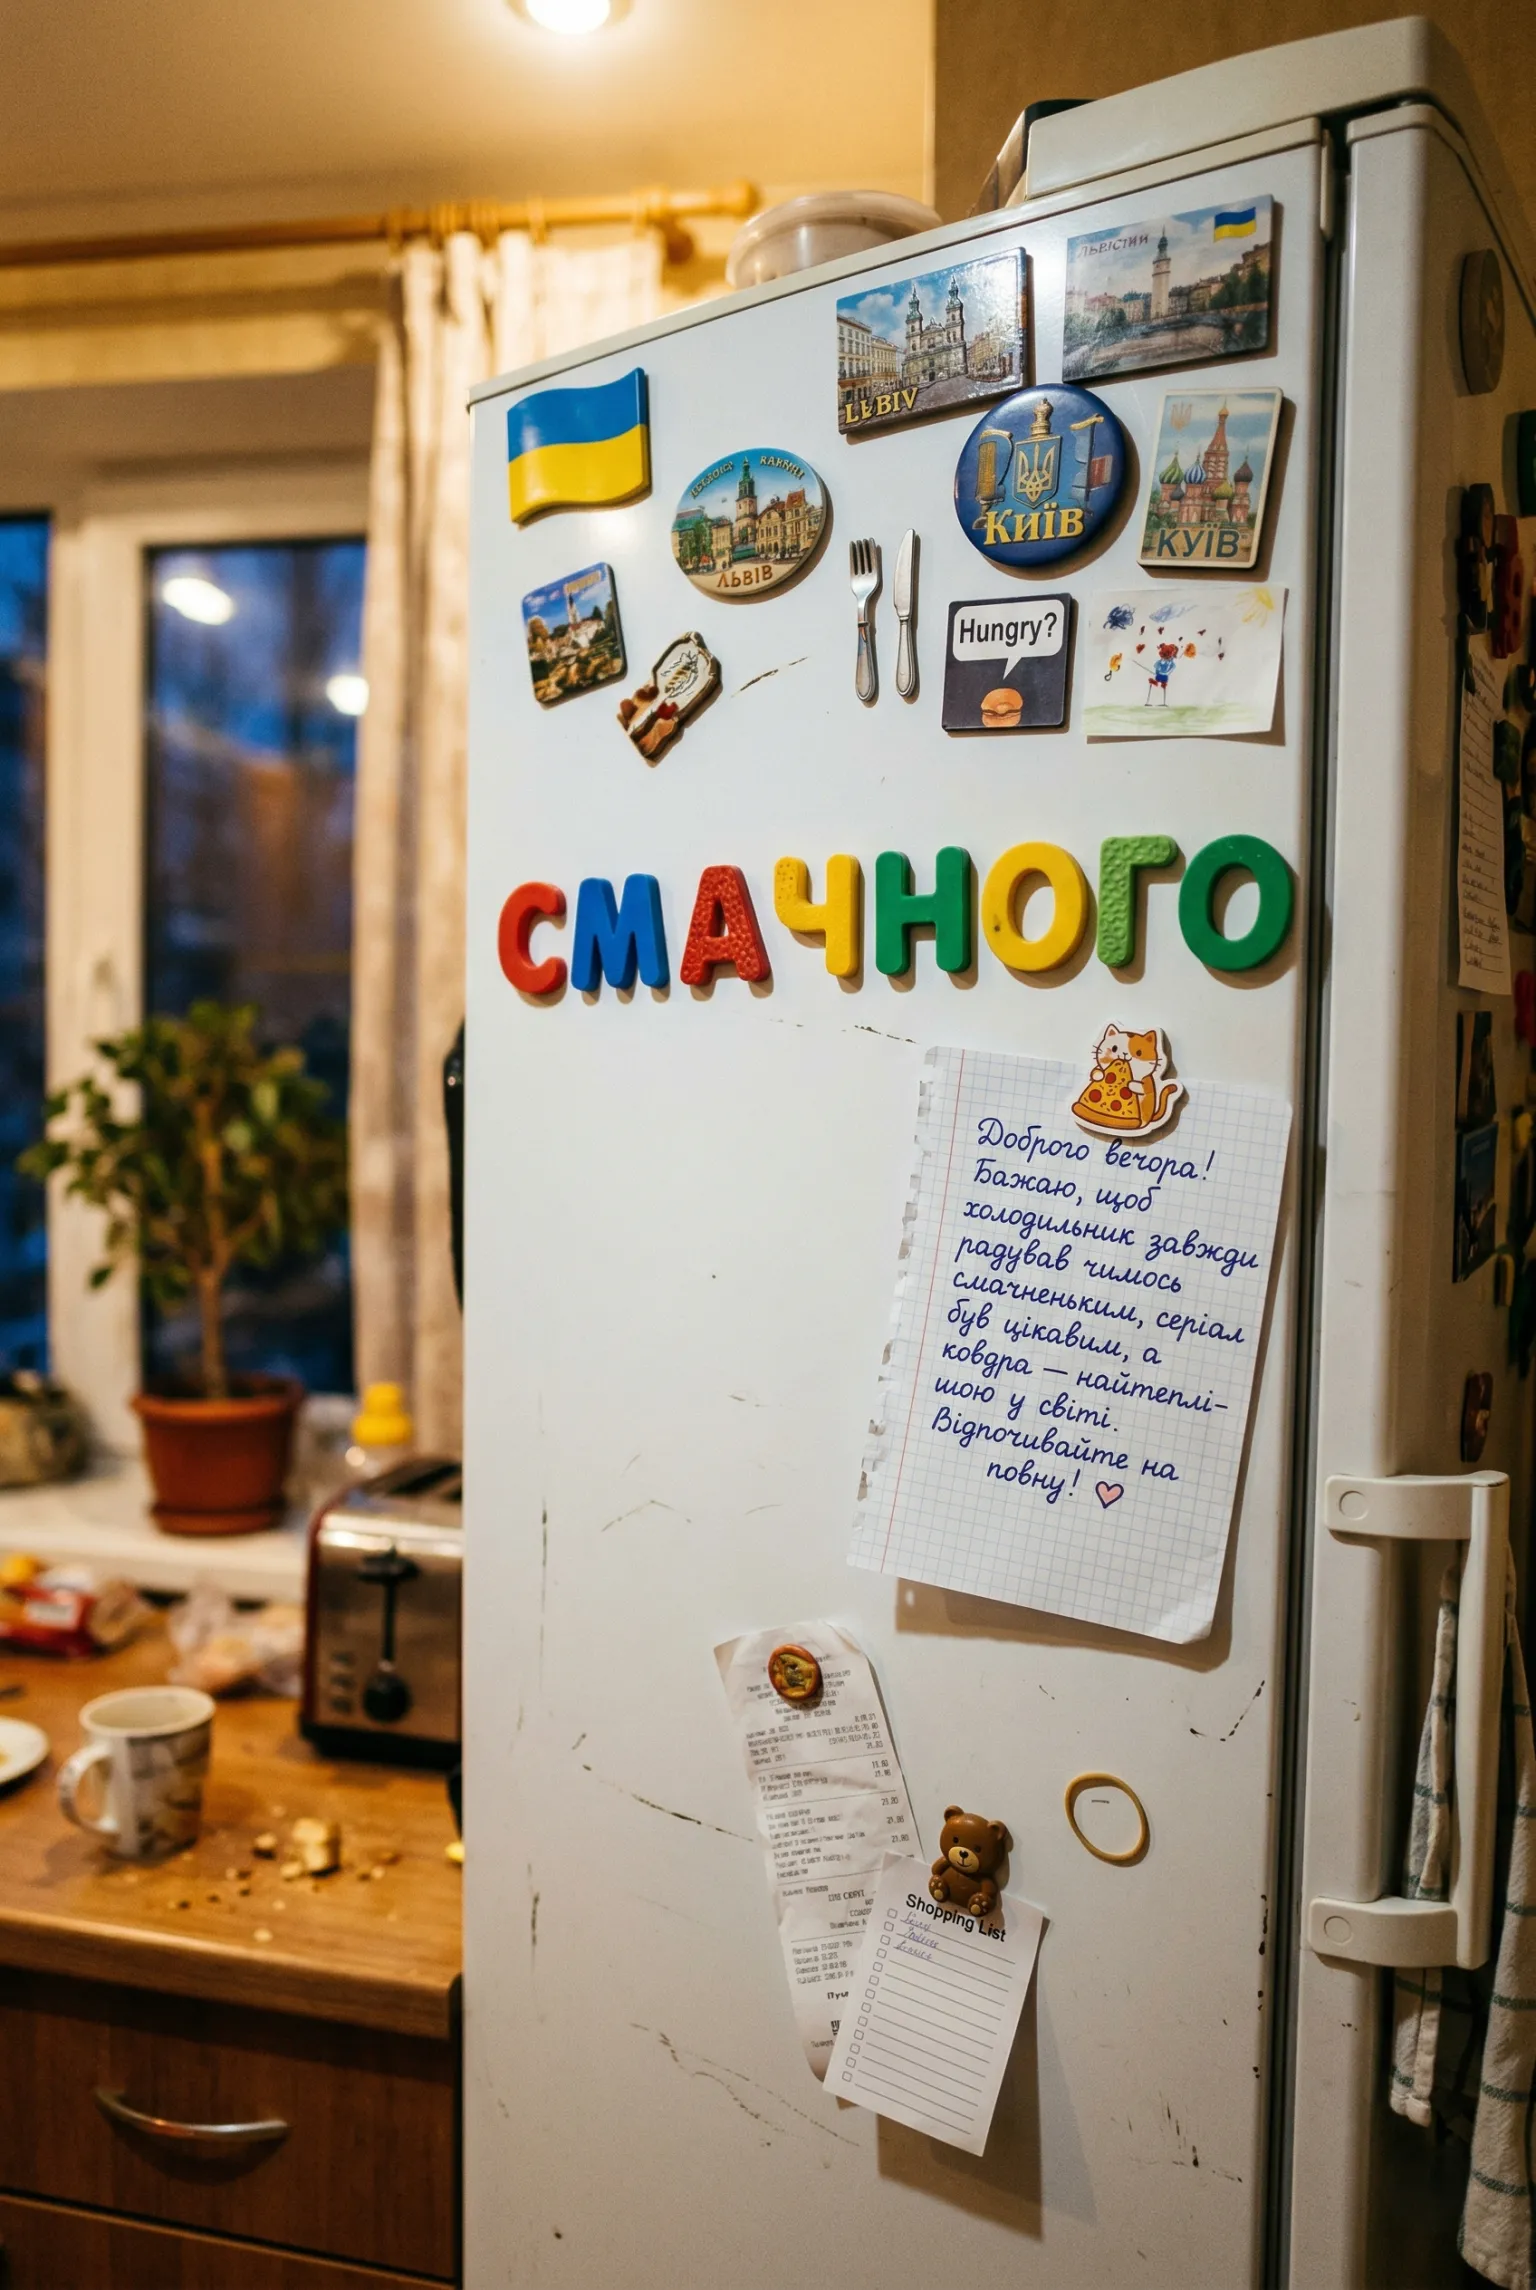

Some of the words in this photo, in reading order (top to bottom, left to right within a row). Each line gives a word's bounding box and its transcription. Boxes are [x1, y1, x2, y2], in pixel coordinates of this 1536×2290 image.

[983, 502, 1086, 546] Київ
[1157, 522, 1241, 558] КУЇВ
[716, 564, 774, 588] ЛЬВІВ
[959, 612, 1058, 647] Hungry?
[497, 834, 1295, 996] СМАЧНОГО
[977, 1117, 1090, 1162] Доброго
[1105, 1138, 1215, 1184] вечора!
[973, 1157, 1084, 1206] Бажаю,
[1095, 1185, 1161, 1214] щоб
[954, 1235, 1070, 1274] радував
[1084, 1260, 1182, 1294] чимось
[962, 1200, 1135, 1247] холодильник
[1144, 1229, 1260, 1277] завжди
[947, 1298, 993, 1337] був
[1003, 1317, 1130, 1363] цікавим,
[1142, 1347, 1162, 1365] а
[952, 1270, 1145, 1328] смачненьким,
[1155, 1310, 1246, 1344] серіал
[934, 1378, 996, 1403] шою
[1007, 1393, 1026, 1421] у
[1038, 1391, 1119, 1433] світі.
[941, 1339, 1032, 1379] ковдра
[1075, 1368, 1229, 1414] найтеплі-
[931, 1406, 1130, 1470] Відпочивайте
[1141, 1460, 1180, 1481] на
[986, 1460, 1080, 1505] повну!
[905, 1893, 975, 1934] Shopping
[978, 1919, 1007, 1943] List
